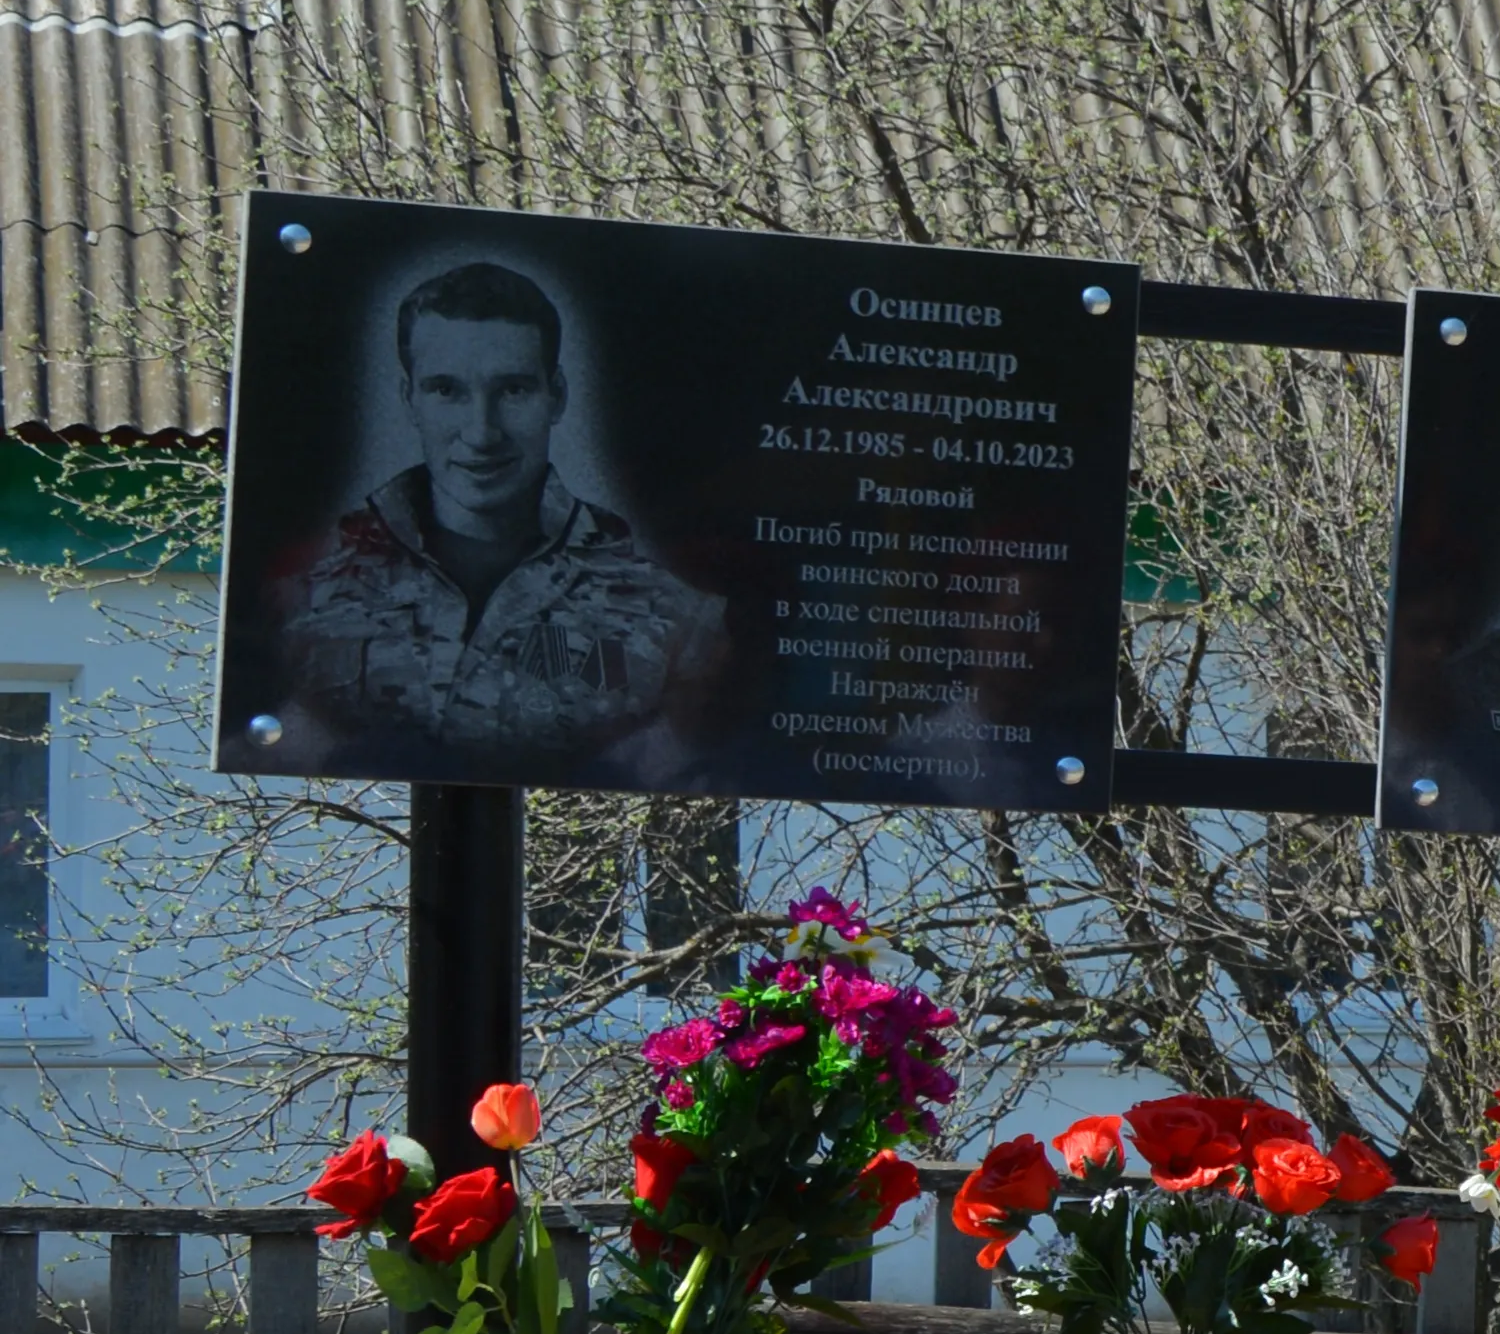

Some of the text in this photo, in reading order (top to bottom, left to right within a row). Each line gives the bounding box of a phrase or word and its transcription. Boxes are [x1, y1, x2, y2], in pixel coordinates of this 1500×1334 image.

[849, 286, 1002, 327] Осинцев
[827, 332, 1018, 382] Александр
[782, 375, 1057, 424] Александрович
[759, 423, 905, 457] 26.12.1985
[932, 436, 1074, 469] 04.10.2023
[857, 477, 974, 509] Рядовой
[755, 515, 1068, 561] Погиб при исполнении
[800, 563, 1020, 595] воинского долга
[775, 599, 1040, 633] в ходе специальной
[777, 636, 1033, 671] военной операции.
[829, 670, 979, 712] Награждён
[771, 706, 1032, 746] орденом Мужества
[812, 747, 986, 780] (посмертно).
